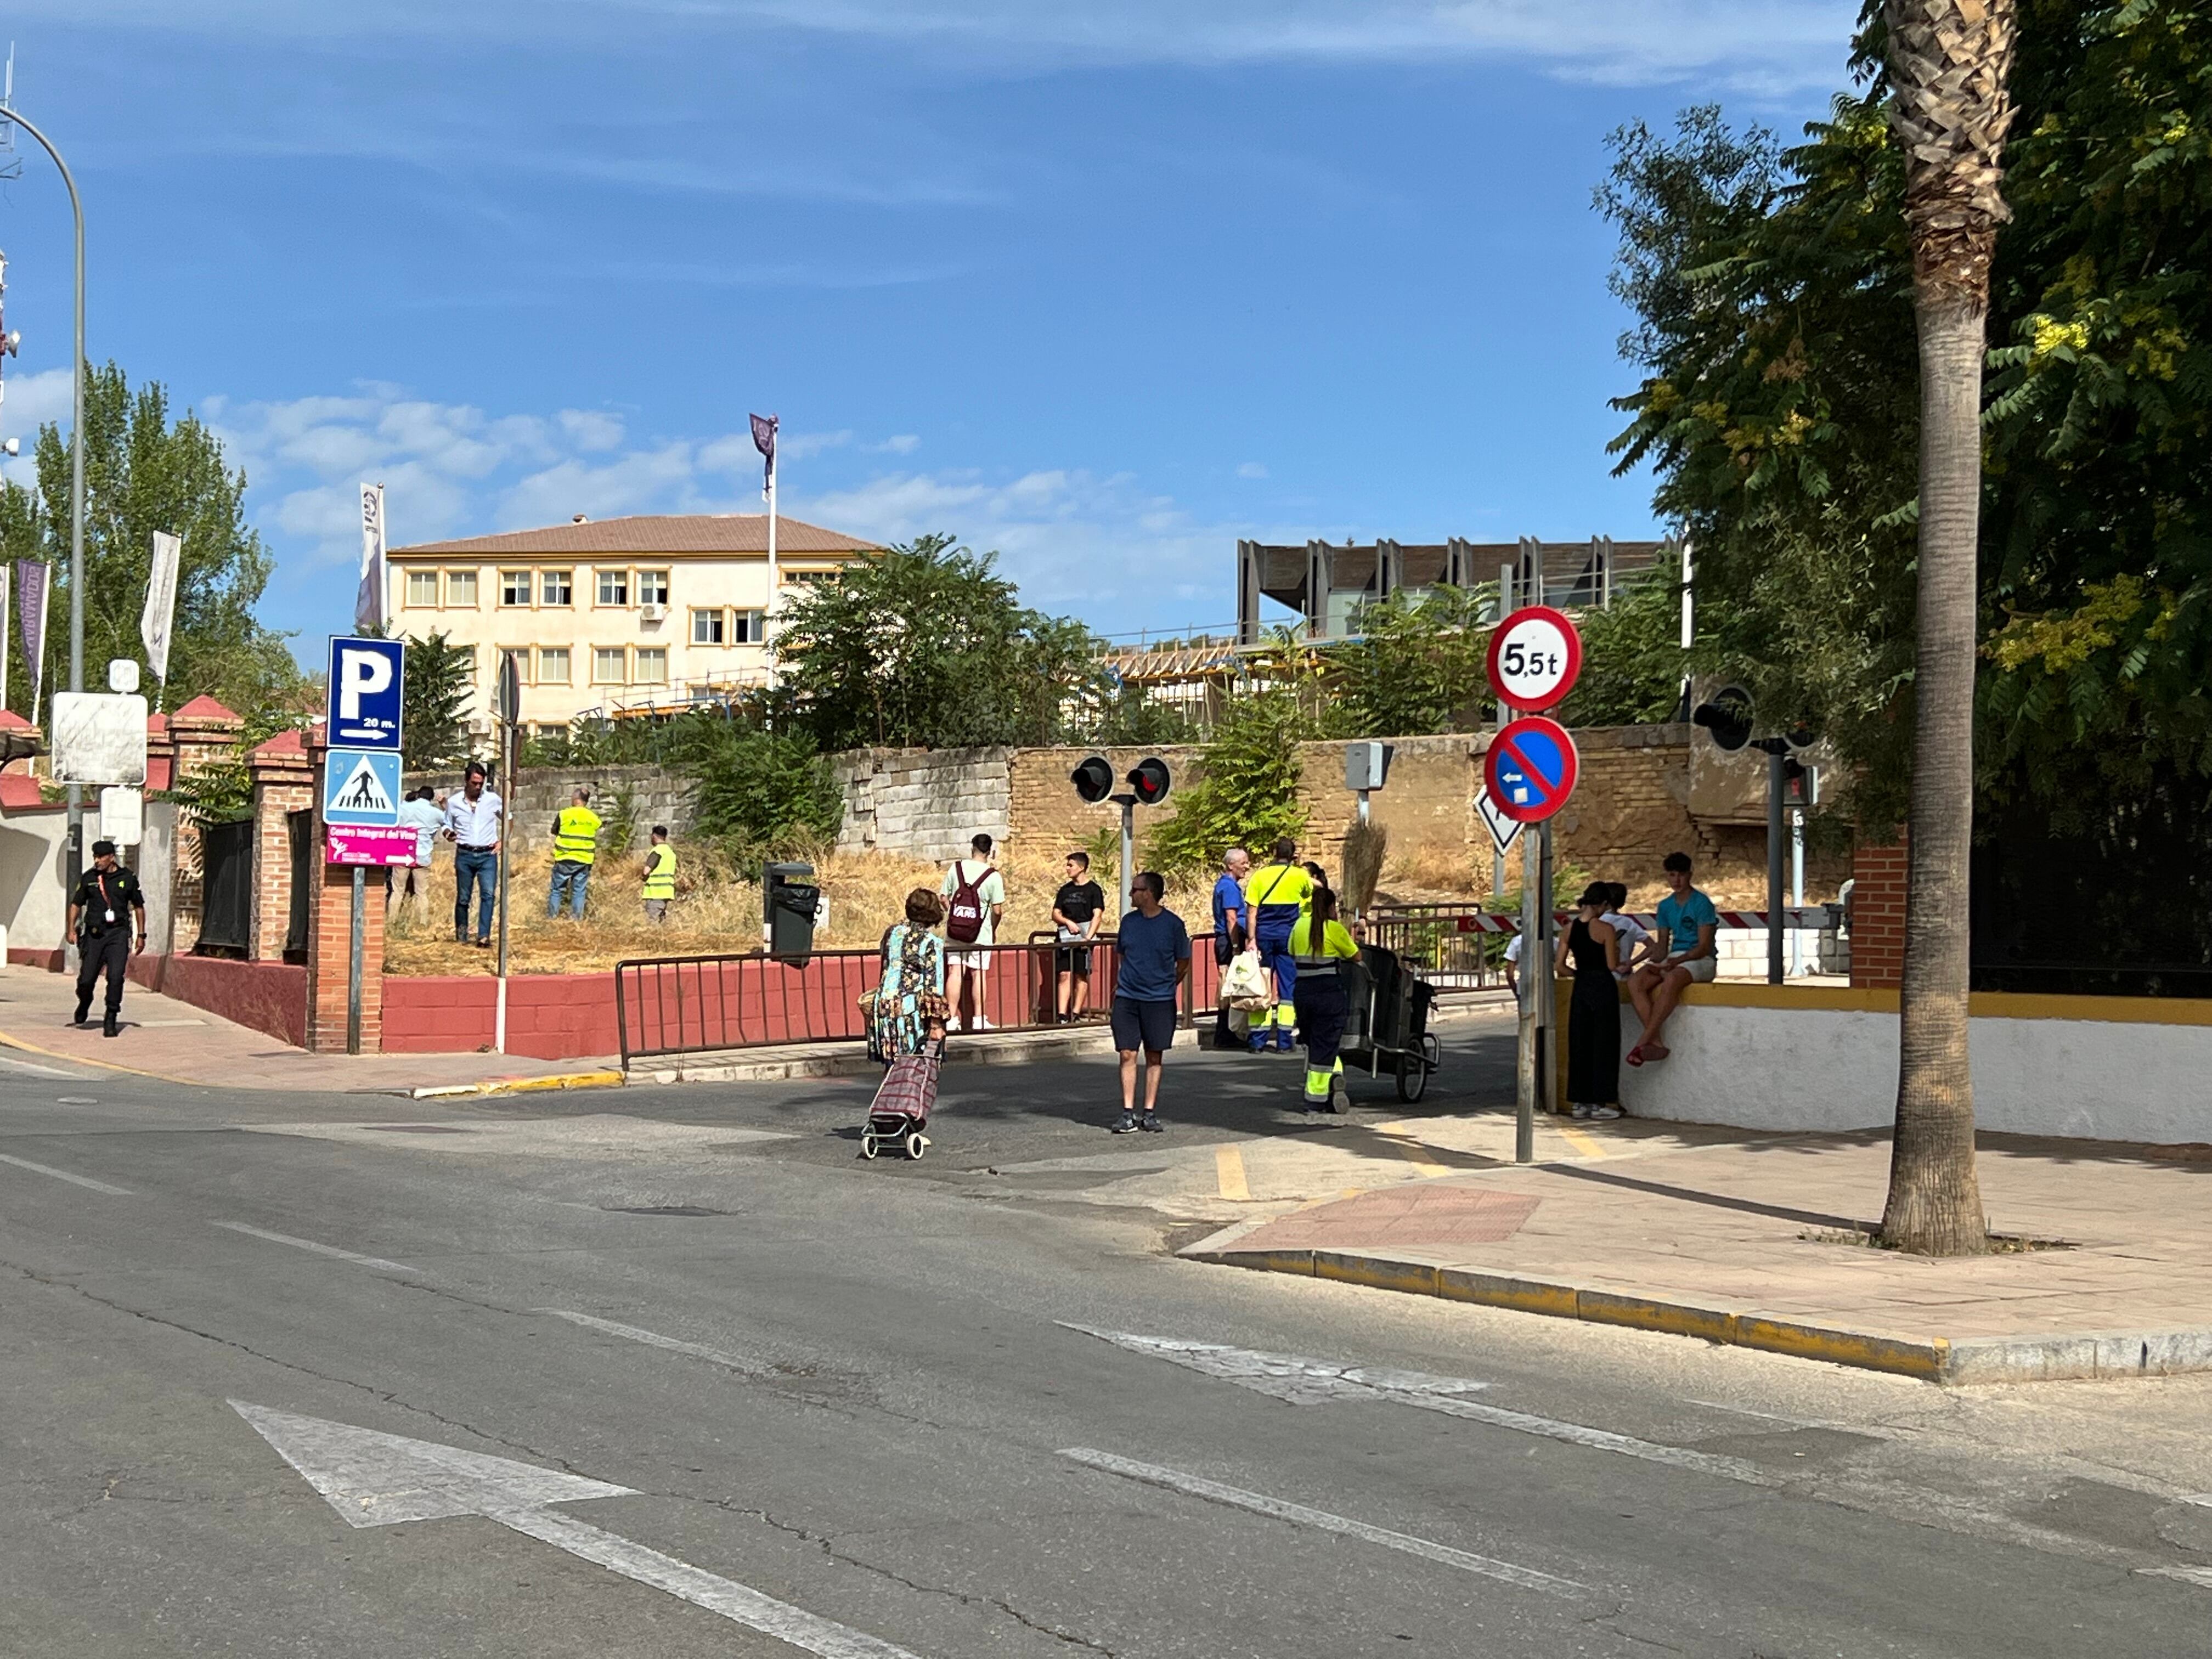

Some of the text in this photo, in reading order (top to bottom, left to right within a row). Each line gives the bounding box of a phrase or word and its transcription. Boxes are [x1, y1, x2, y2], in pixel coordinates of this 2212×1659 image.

[340, 648, 392, 719] P
[363, 718, 378, 727] 20
[330, 826, 416, 840] Centro Integral del Vino
[953, 904, 977, 918] VANS
